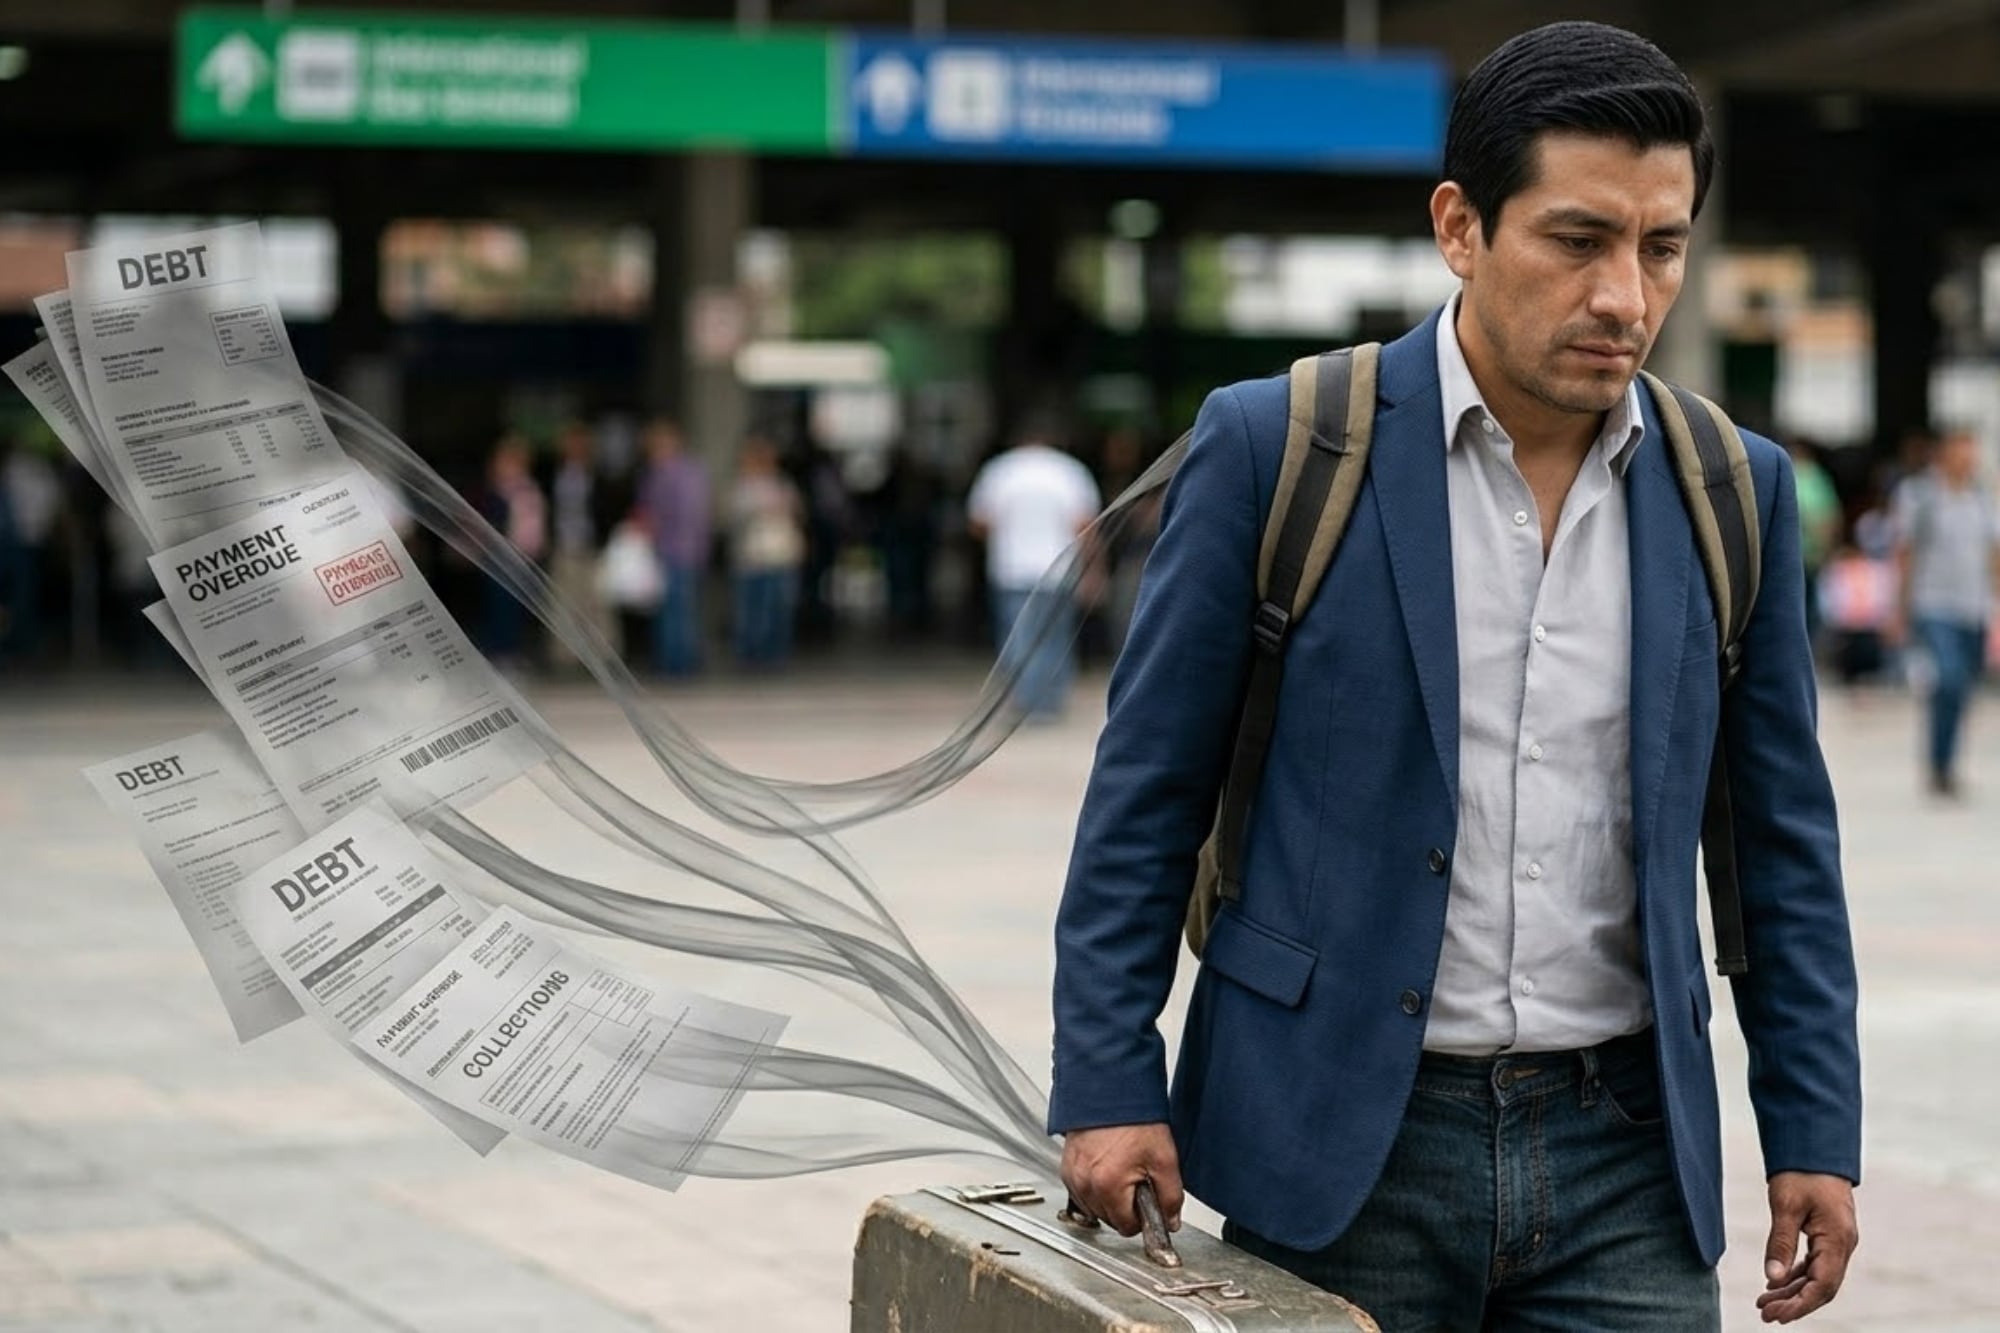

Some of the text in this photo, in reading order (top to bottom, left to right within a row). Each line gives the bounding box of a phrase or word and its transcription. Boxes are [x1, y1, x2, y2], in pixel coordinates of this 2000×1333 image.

[118, 246, 208, 289] DEBT
[176, 525, 287, 584] PAYMENT
[188, 544, 302, 602] OVERDUE
[115, 755, 185, 791] DEBT
[271, 837, 365, 912] DEBT
